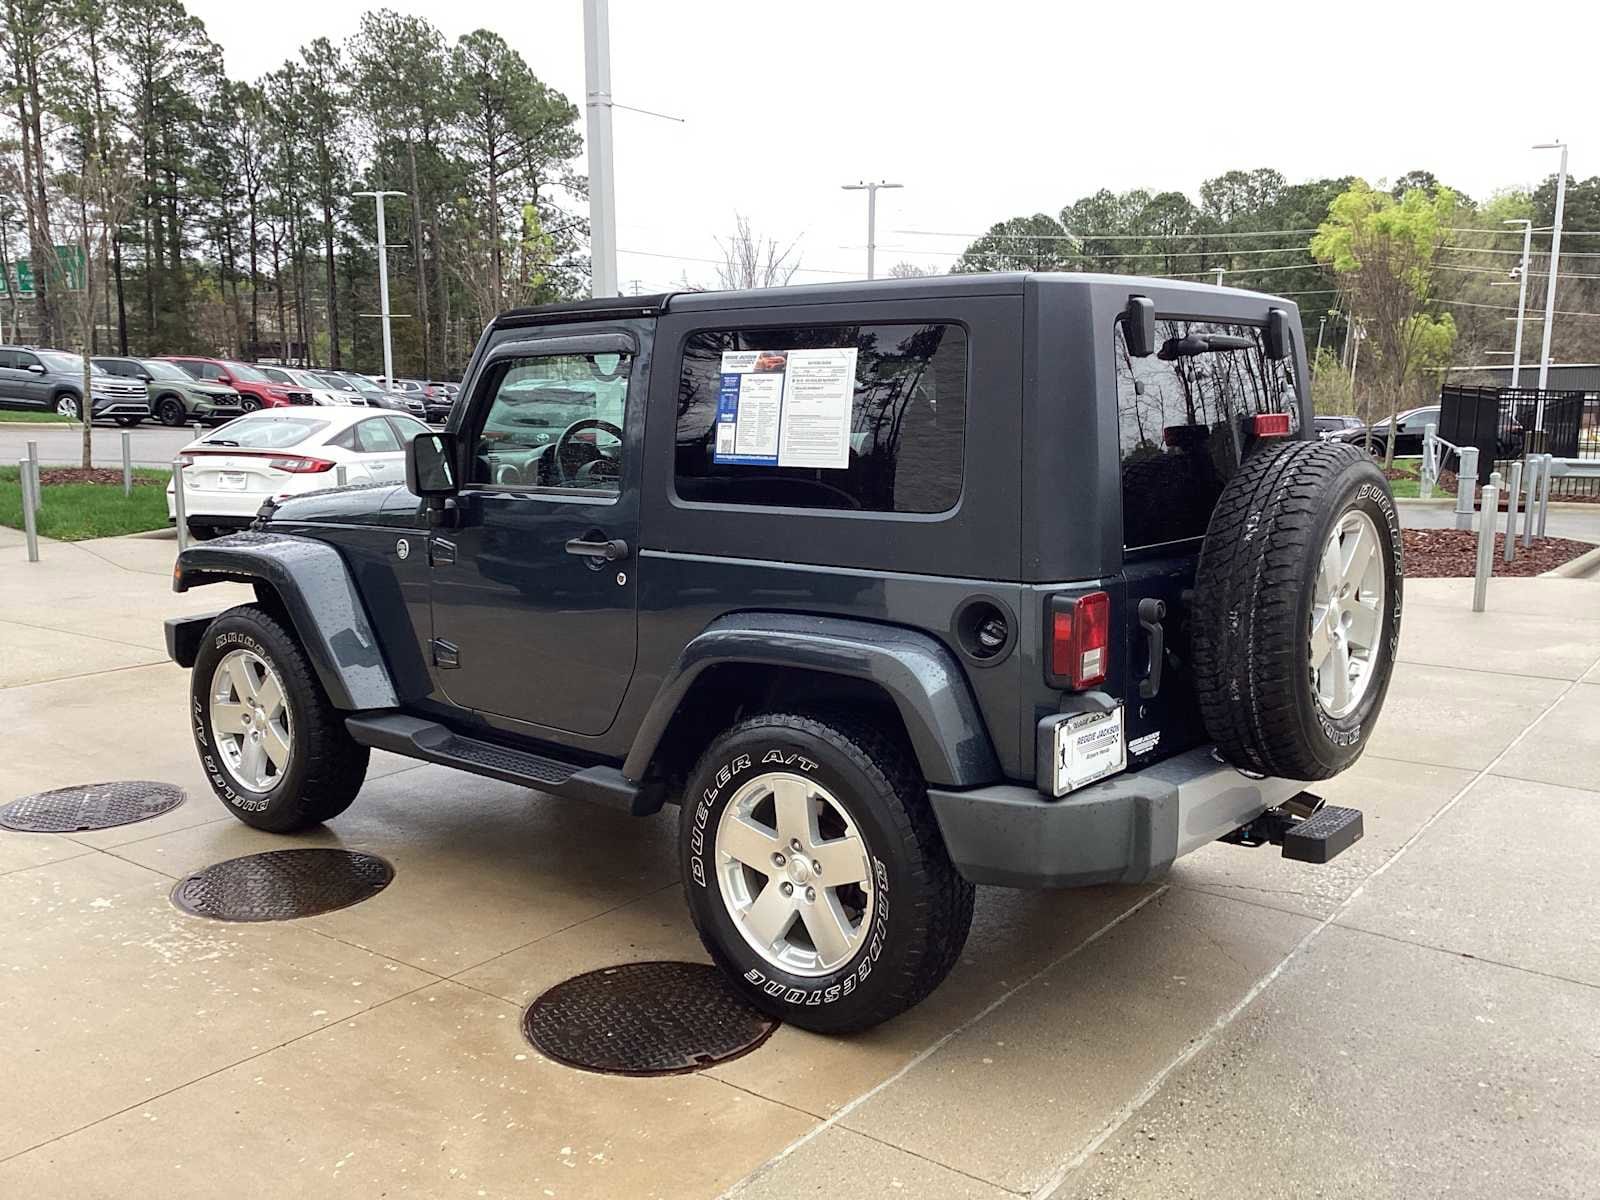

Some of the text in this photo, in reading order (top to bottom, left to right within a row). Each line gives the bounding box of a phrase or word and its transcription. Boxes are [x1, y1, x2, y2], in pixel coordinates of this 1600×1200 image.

[1097, 724, 1120, 738] JACKSON
[204, 755, 270, 811] DUELER
[689, 749, 820, 888] DUELER A/T
[743, 855, 891, 1006] BRIDGESTONE
